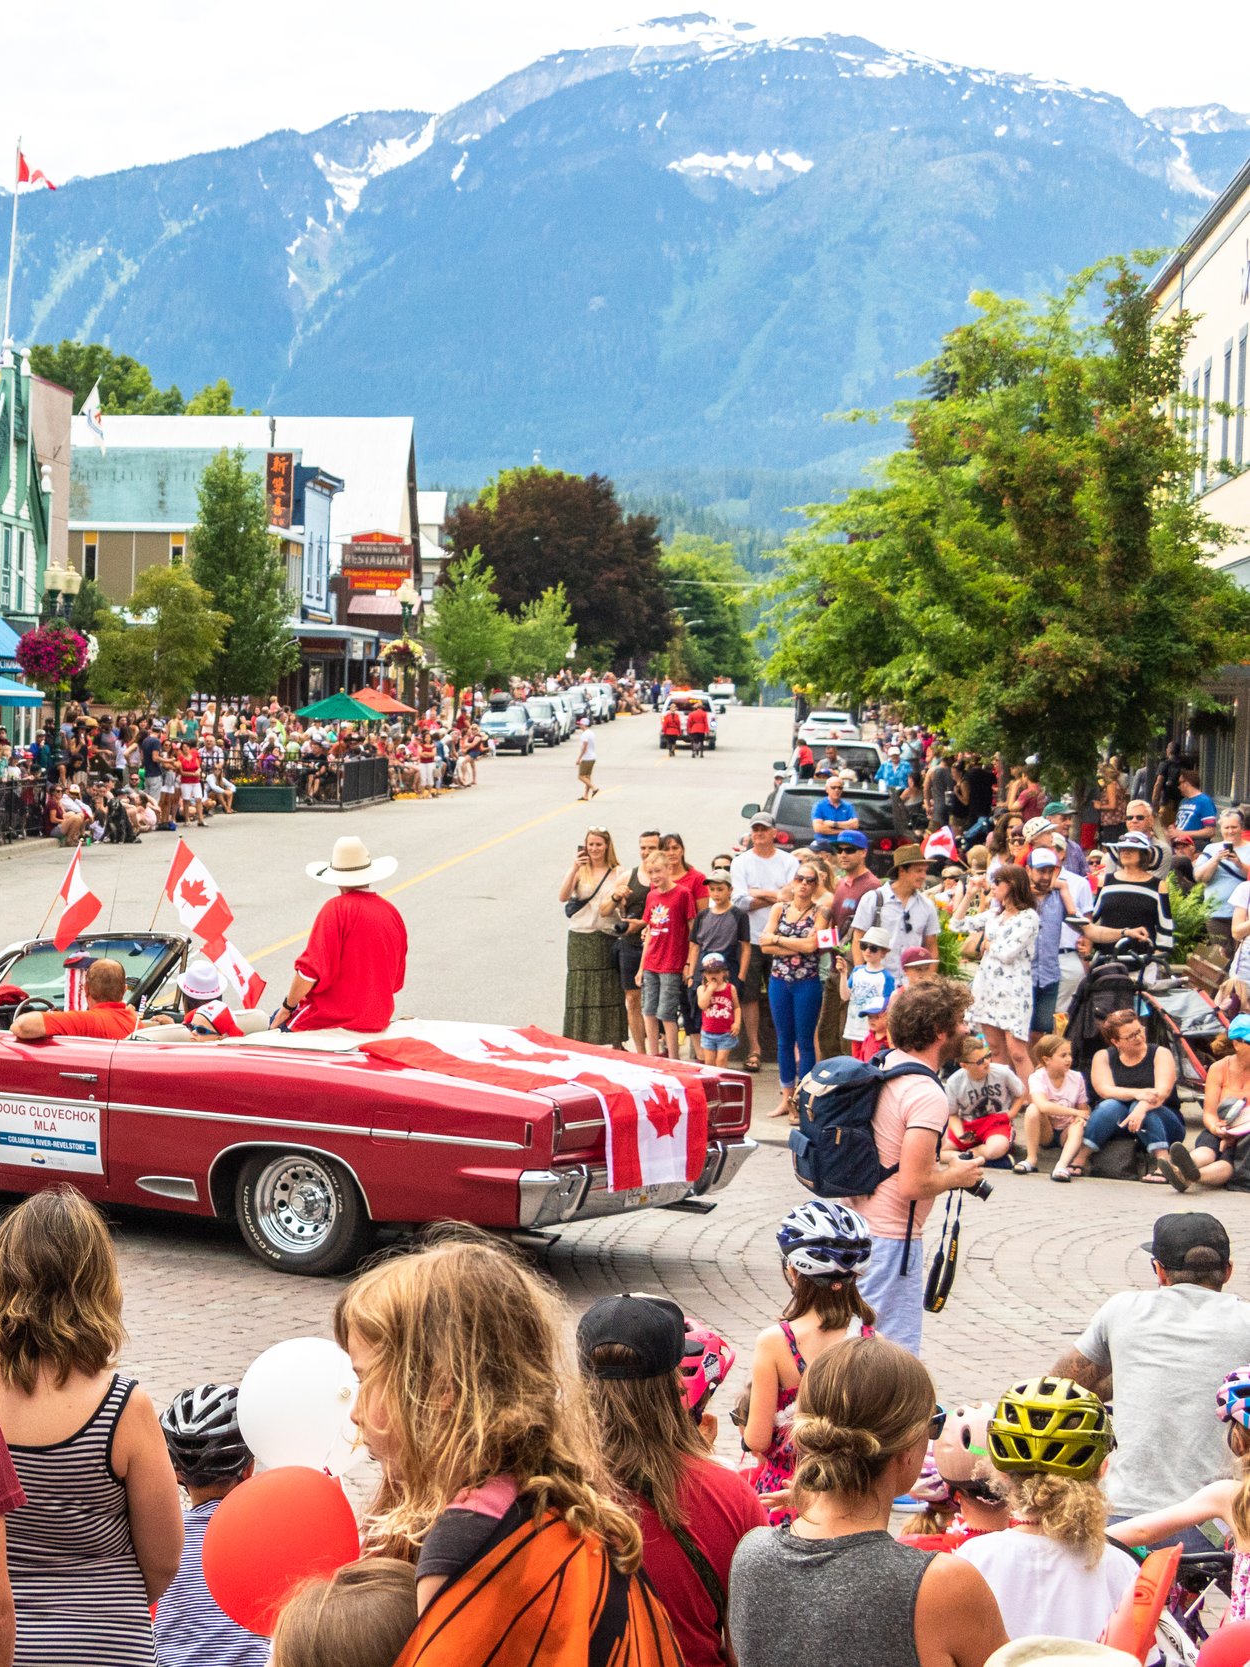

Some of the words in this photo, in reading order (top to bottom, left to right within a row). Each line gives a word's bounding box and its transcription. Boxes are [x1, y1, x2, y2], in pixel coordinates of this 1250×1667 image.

[344, 554, 410, 566] RESTAURANT
[967, 1083, 1002, 1105] FLOSS
[29, 1106, 96, 1123] CLOVECHOK
[34, 1120, 57, 1132] MLA
[7, 1135, 35, 1145] COLUMBIA
[35, 1138, 87, 1151] RIVER-REVELSTOKE
